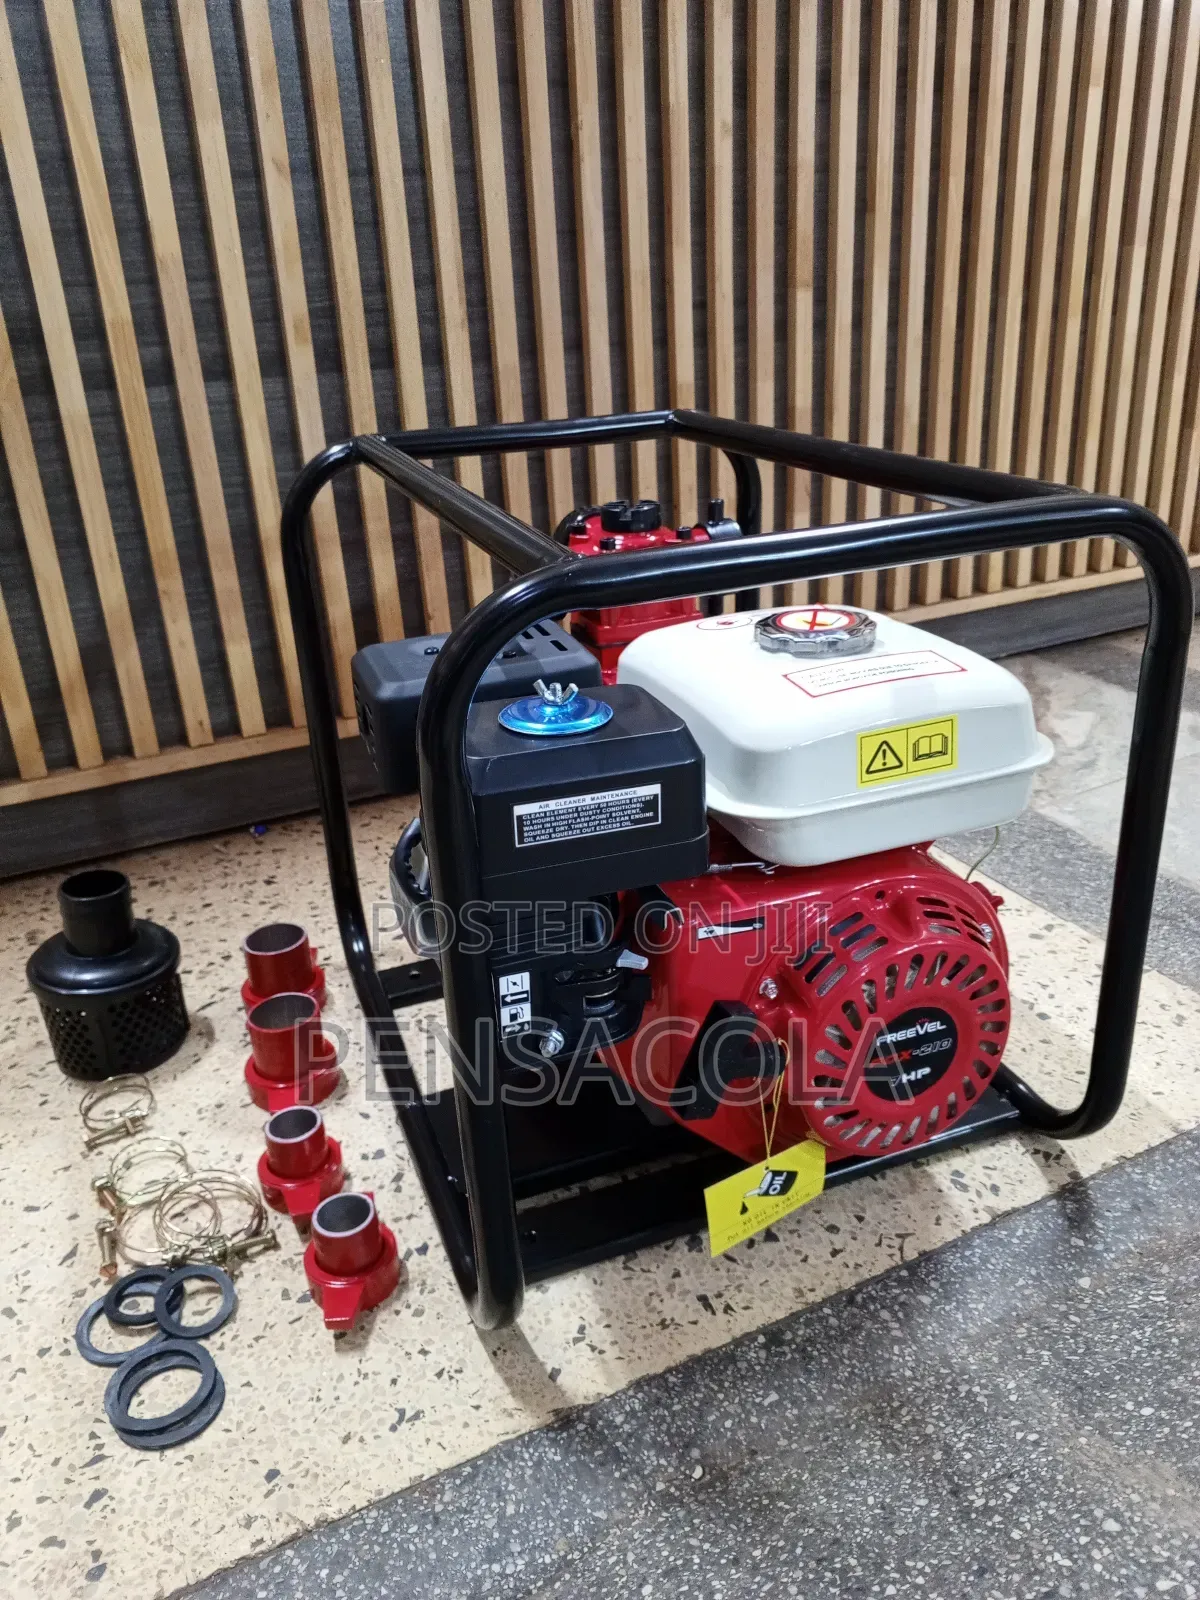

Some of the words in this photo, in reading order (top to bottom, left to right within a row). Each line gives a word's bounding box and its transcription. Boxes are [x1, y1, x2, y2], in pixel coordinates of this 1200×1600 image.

[555, 798, 586, 807] CLEANER
[591, 790, 637, 802] MAINTENANCE
[546, 808, 576, 816] ELEMENT
[569, 814, 610, 824] FLASH-POINT
[524, 829, 554, 837] SQUEEZE
[631, 812, 654, 820] ENGINE
[551, 830, 581, 838] SQUEEZE
[596, 823, 620, 831] EXCESS
[876, 1021, 947, 1046] FREEVEL
[768, 1171, 788, 1195] OIL
